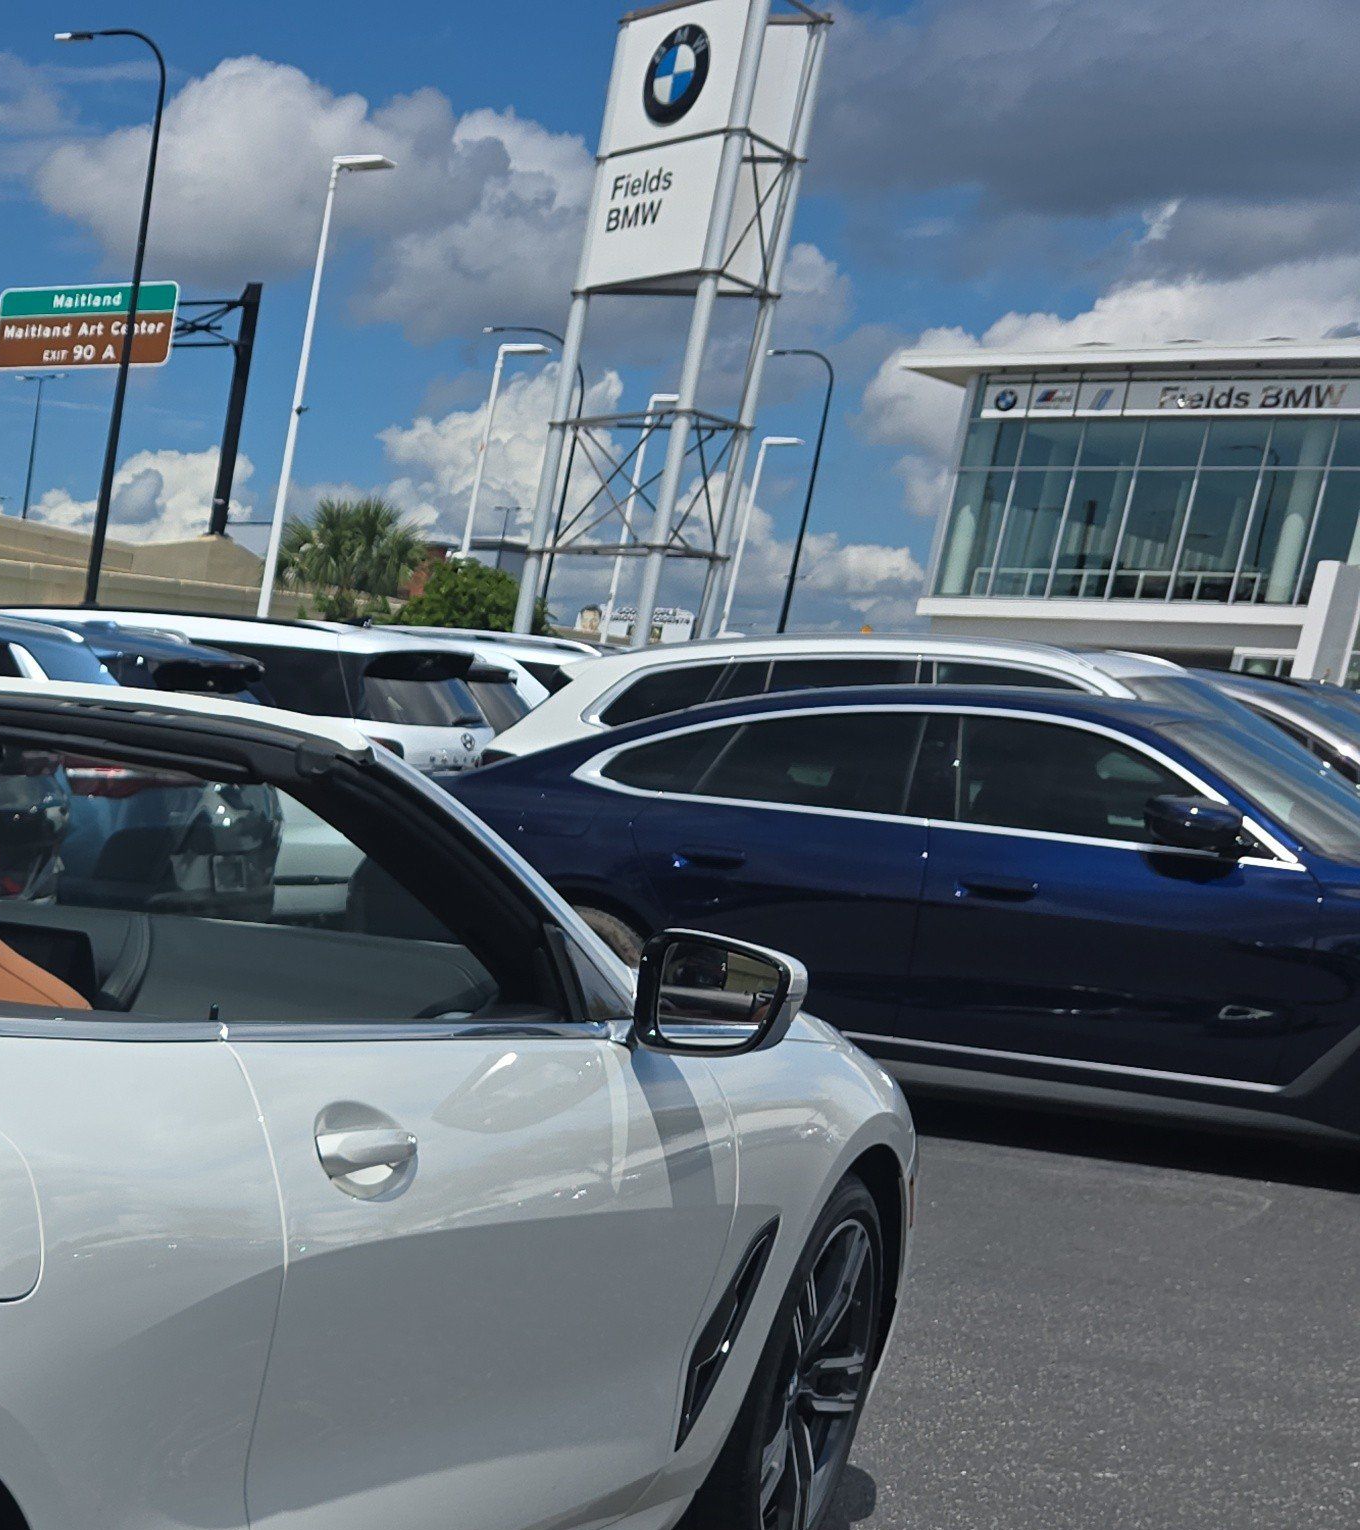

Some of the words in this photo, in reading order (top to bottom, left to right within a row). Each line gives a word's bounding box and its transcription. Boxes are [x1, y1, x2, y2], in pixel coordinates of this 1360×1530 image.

[611, 167, 673, 200] Fields
[605, 199, 663, 232] BMW
[52, 291, 123, 309] Maitland
[3, 322, 72, 340] Maitland
[78, 321, 104, 337] Art
[42, 349, 69, 363] EXIT
[73, 344, 96, 362] 90
[101, 343, 117, 361] A
[1258, 383, 1348, 410] BMW
